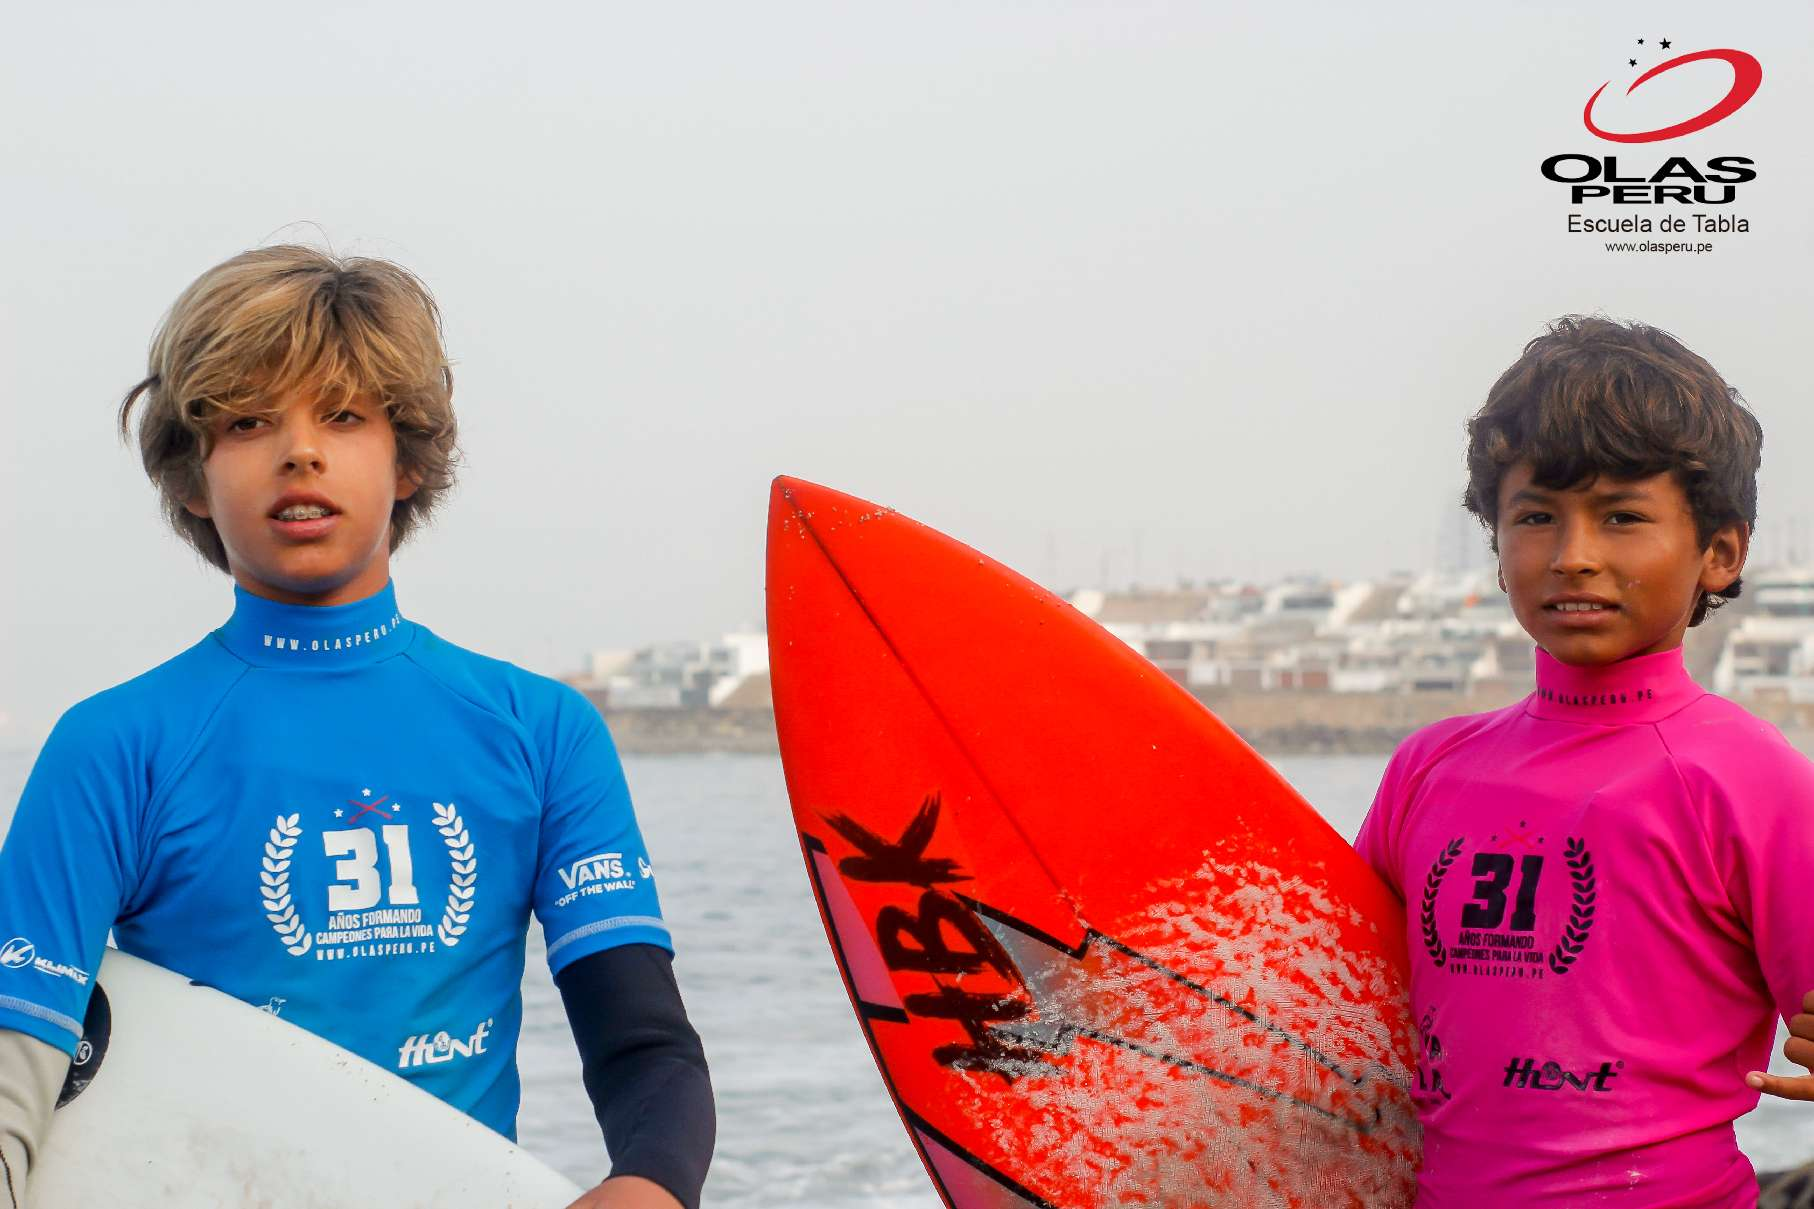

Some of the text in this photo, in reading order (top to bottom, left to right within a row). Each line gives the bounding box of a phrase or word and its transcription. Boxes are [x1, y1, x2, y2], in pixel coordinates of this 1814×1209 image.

[322, 824, 420, 912] 31
[579, 883, 603, 896] THE
[1461, 852, 1544, 932] 31
[328, 908, 422, 930] AÑOS FORMANDO
[315, 924, 434, 945] CAMPEONES PARA LA VIDA
[1458, 931, 1535, 950] AÑOS FORMANDO
[316, 942, 436, 960] WWW.OLASPERU.PE
[1449, 948, 1490, 961] CAMPEONES
